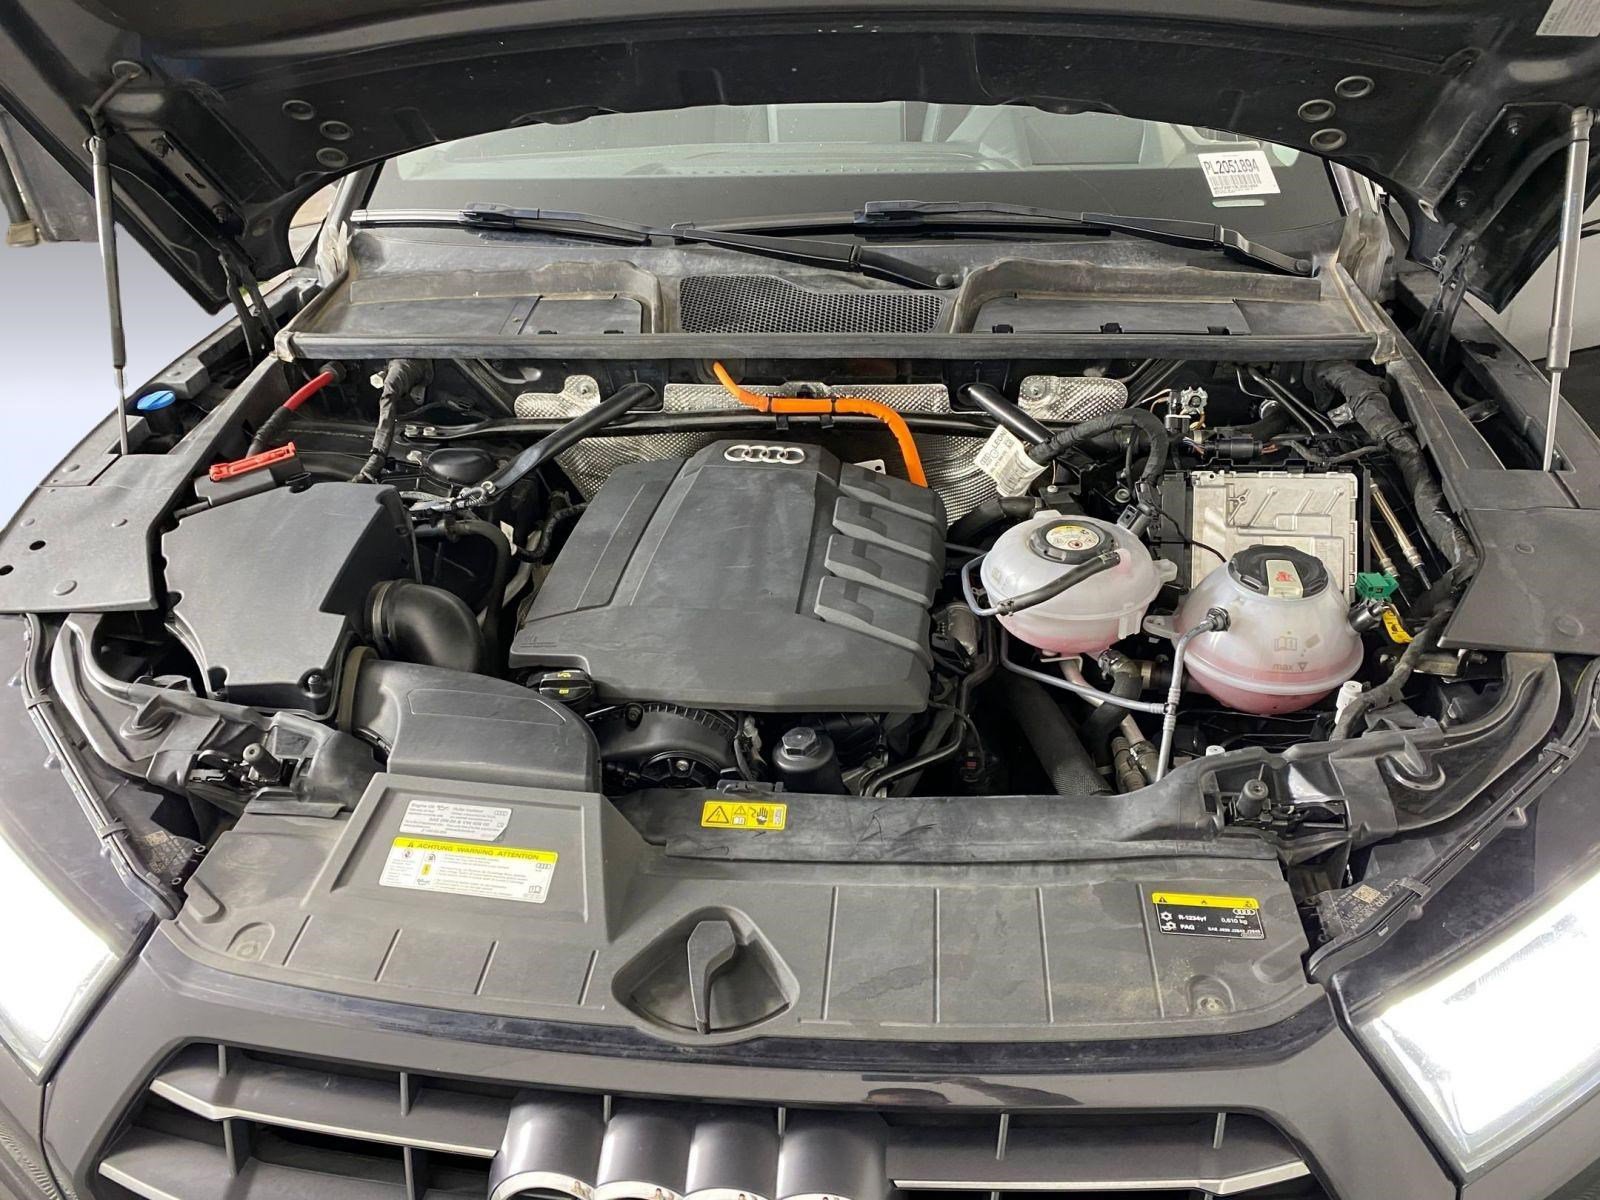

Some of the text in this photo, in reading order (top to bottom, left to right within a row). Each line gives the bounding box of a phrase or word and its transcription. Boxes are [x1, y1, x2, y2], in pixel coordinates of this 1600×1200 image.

[1203, 158, 1260, 175] PL2051894
[1272, 663, 1292, 671] max
[417, 843, 540, 860] ACHTUNG WARNING ATTENTION
